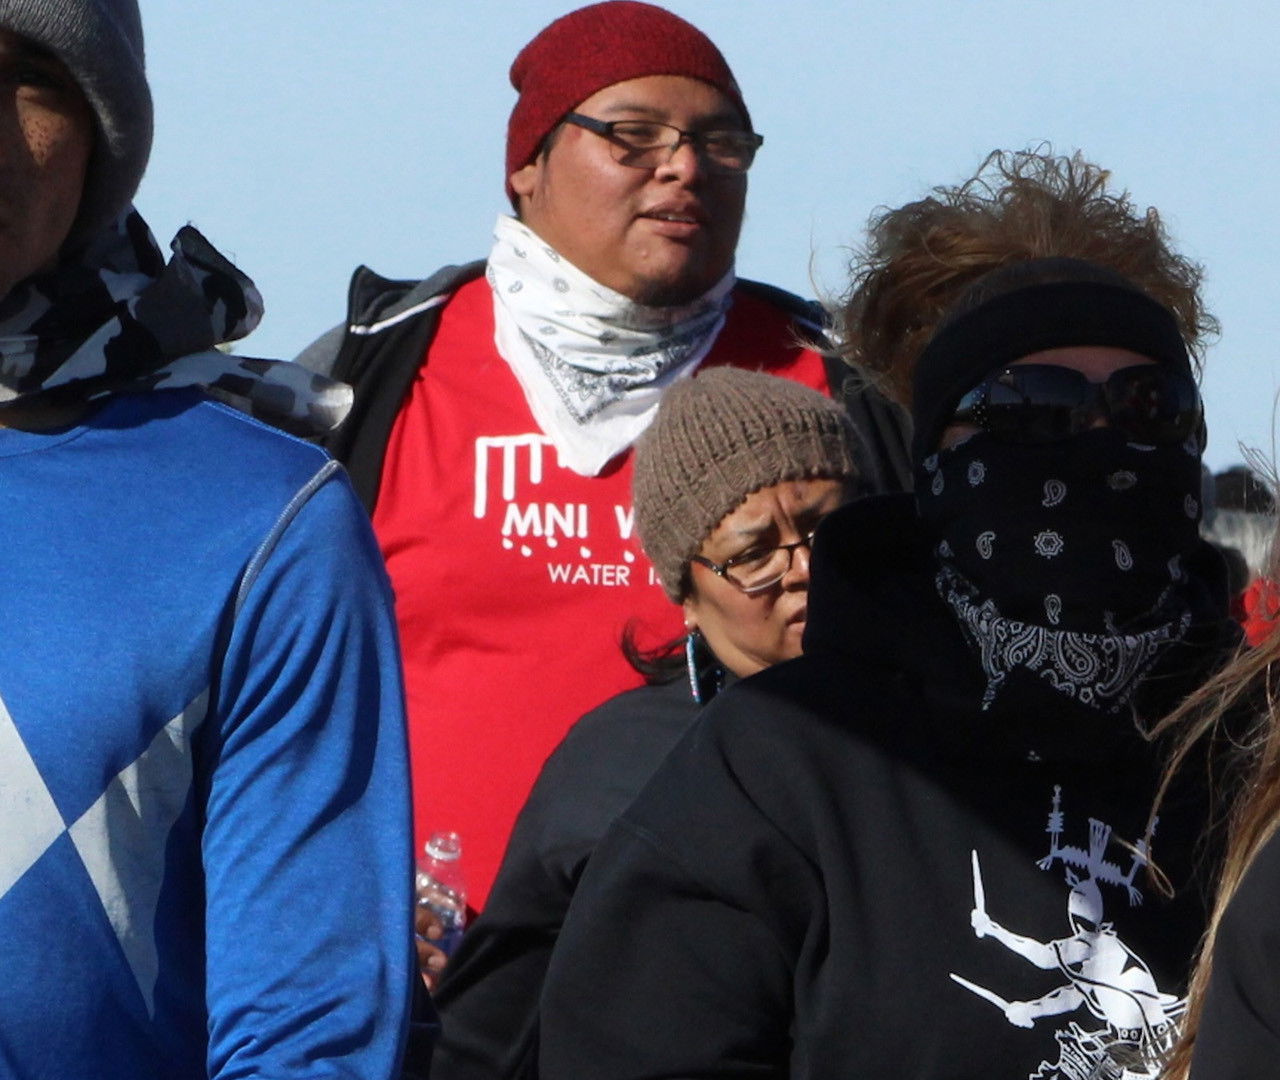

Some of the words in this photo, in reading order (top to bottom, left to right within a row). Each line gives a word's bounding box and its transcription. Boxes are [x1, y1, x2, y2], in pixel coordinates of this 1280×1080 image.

[501, 502, 588, 539] MNI
[547, 563, 630, 586] WATER
[648, 566, 662, 586] I
